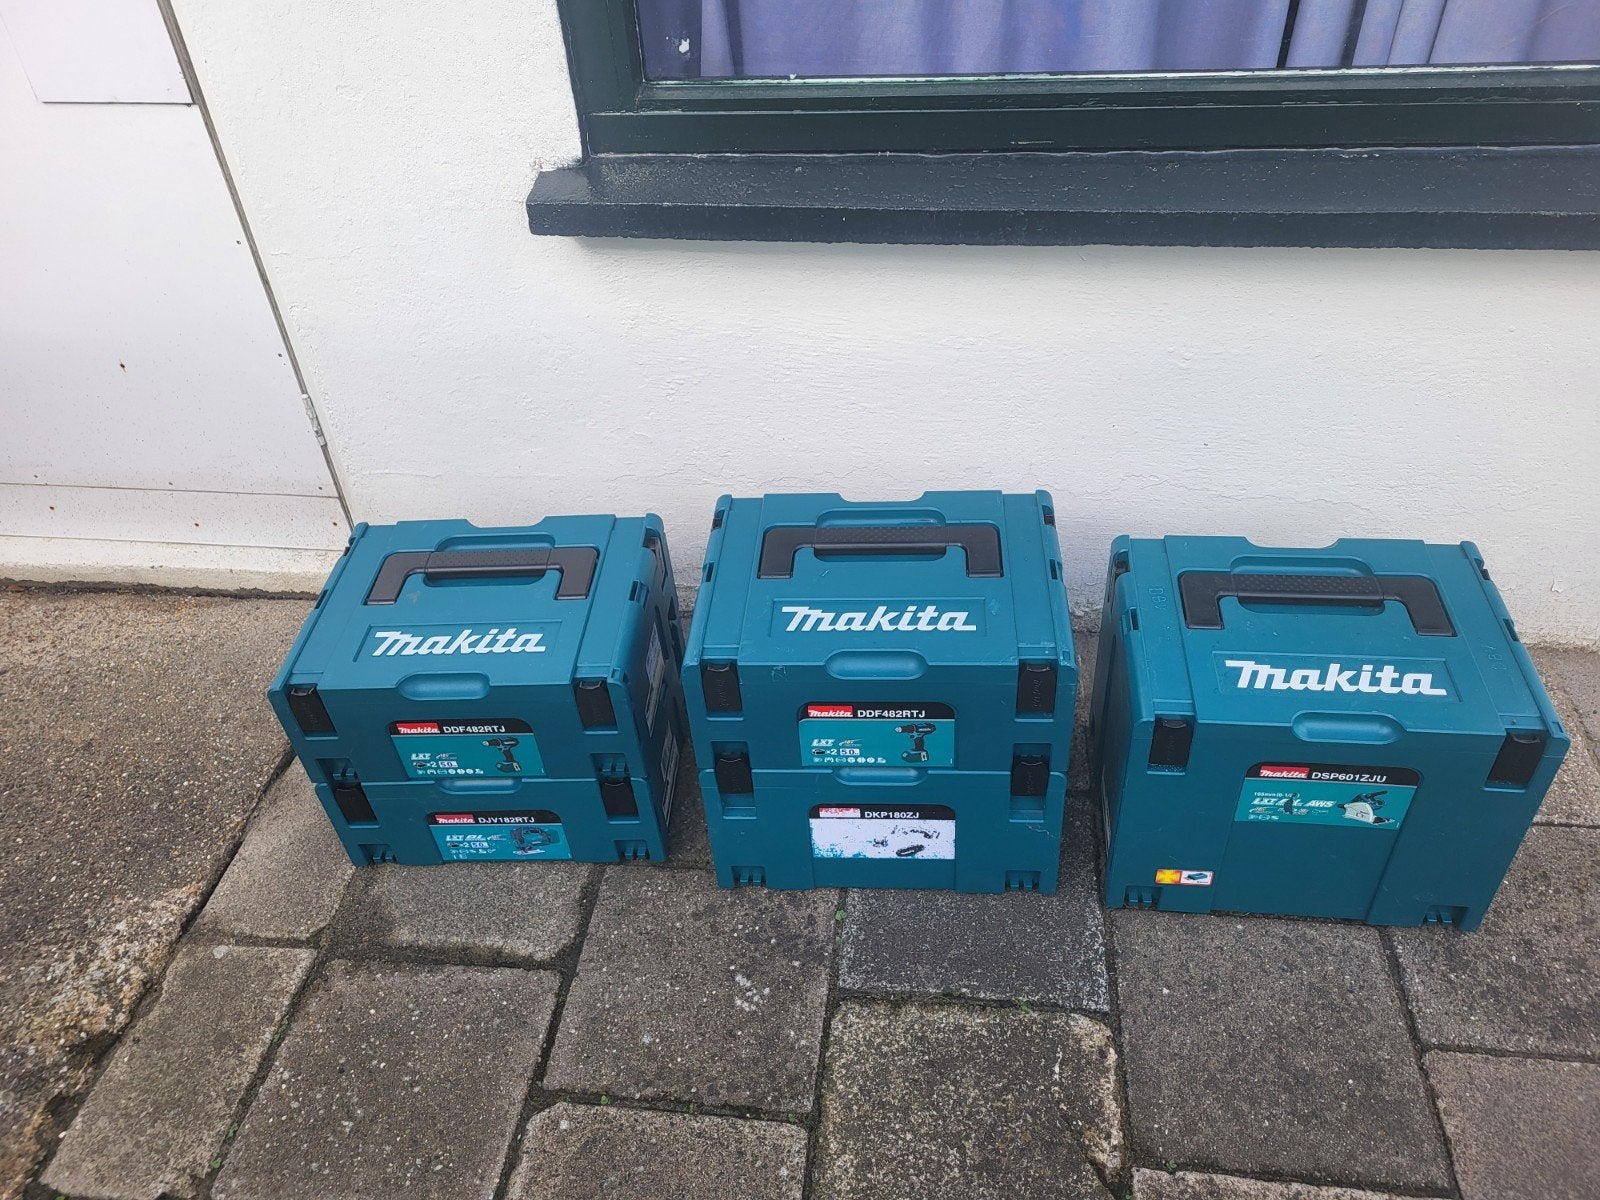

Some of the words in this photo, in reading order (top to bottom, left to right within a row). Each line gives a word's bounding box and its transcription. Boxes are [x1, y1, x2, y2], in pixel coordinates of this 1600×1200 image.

[857, 709, 926, 718] DDF482RTJ
[442, 725, 506, 734] DDF482RTJ
[1311, 772, 1387, 783] DSP601ZJU
[864, 811, 920, 819] DKP180ZJ
[478, 816, 535, 824] DJV182RTJ
